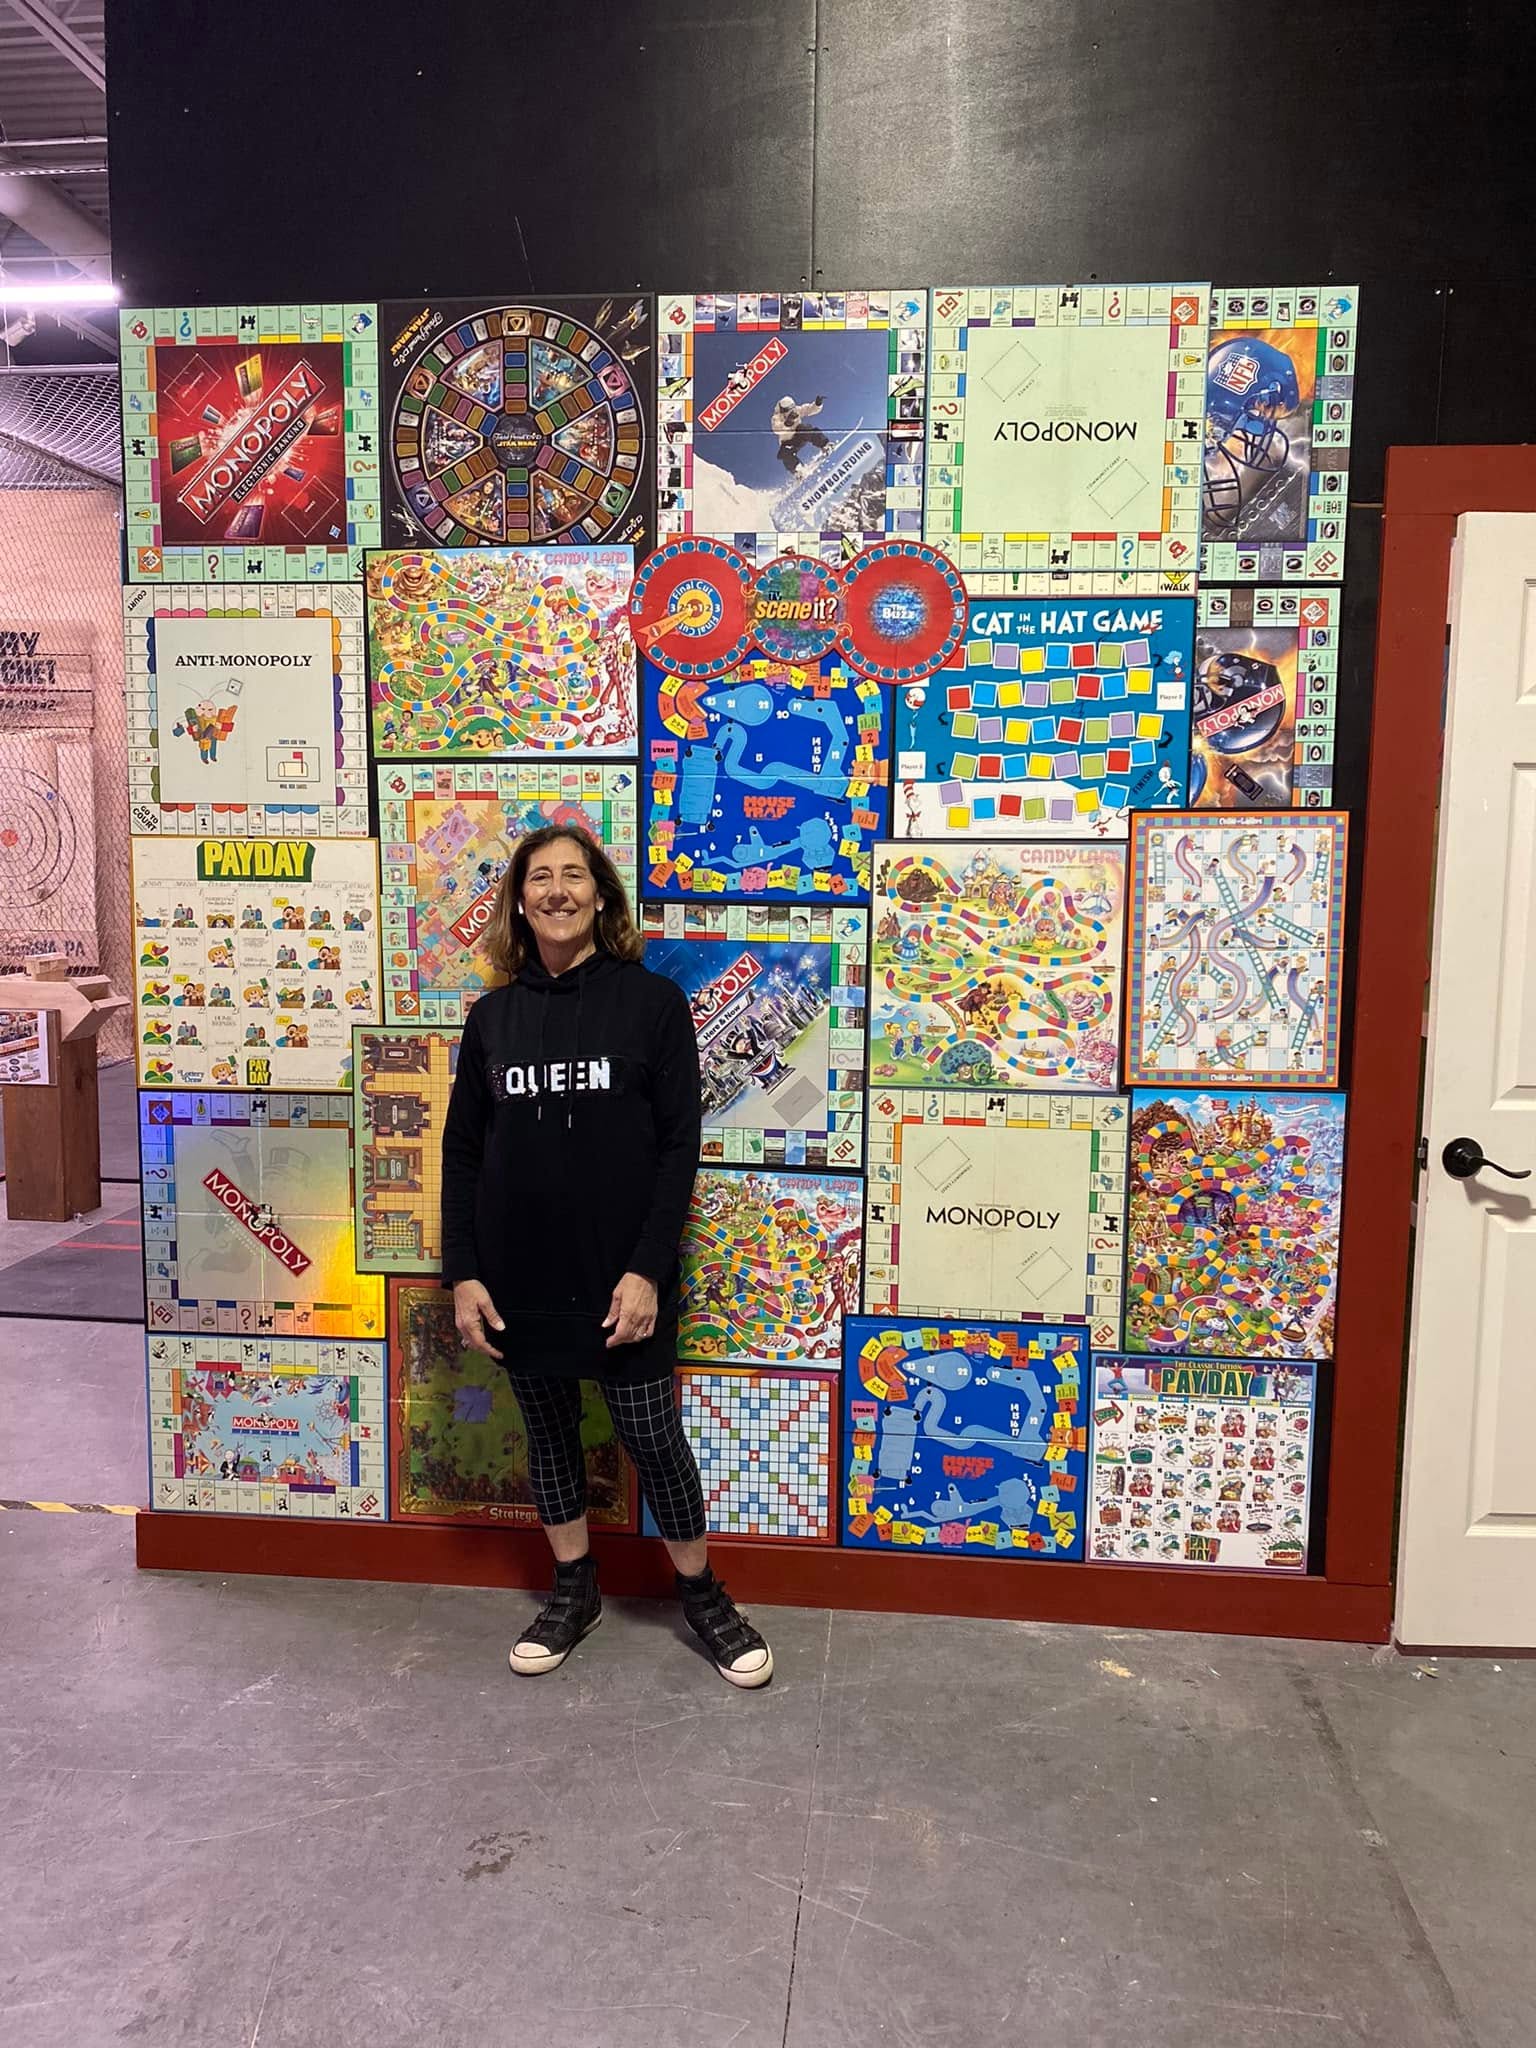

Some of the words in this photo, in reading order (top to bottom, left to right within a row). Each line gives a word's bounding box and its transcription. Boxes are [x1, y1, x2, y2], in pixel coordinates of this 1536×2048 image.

[937, 296, 959, 318] GO
[703, 341, 783, 427] MONOPOLY
[1228, 358, 1257, 392] NFL
[994, 422, 1138, 441] MONOPOLY
[191, 371, 313, 514] MONOPOLY
[233, 453, 274, 501] ELECTRONIC
[273, 420, 306, 454] BANKING
[801, 441, 873, 511] SNOWBOARDING
[544, 552, 589, 565] CANDY
[593, 551, 628, 565] LAND
[1314, 550, 1337, 572] GO
[672, 579, 695, 600] Final
[696, 581, 714, 595] Cut
[1164, 584, 1190, 592] WALK
[127, 590, 147, 612] COURT
[754, 600, 813, 620] scene
[813, 598, 838, 620] it?
[882, 608, 916, 619] Buzz
[1019, 613, 1031, 623] IN
[1041, 611, 1088, 634] HAT
[1093, 609, 1163, 633] GAME
[972, 612, 1014, 635] CAT
[1016, 625, 1036, 635] THE
[175, 654, 312, 668] ANTI-MONOPOLY
[709, 713, 721, 722] 24
[776, 711, 790, 719] 20
[1200, 686, 1285, 735] MONOPOLY
[1133, 770, 1154, 796] FINISH
[715, 794, 721, 803] 9
[743, 796, 796, 809] MOUSE
[132, 808, 157, 832] COURT
[140, 805, 153, 817] GO
[150, 815, 159, 824] TO
[712, 809, 723, 817] 10
[745, 807, 788, 819] TRAP
[710, 842, 716, 850] 6
[736, 835, 742, 843] 7
[203, 840, 310, 878] PAYDAY
[1020, 849, 1077, 864] CANDY
[1079, 849, 1121, 864] LAND
[702, 1022, 721, 1041] Here
[725, 1004, 741, 1020] Now
[181, 1070, 204, 1079] Lottery
[249, 1059, 267, 1072] PAY
[249, 1072, 269, 1084] DAY
[504, 1058, 611, 1096] QUEEN
[835, 1139, 855, 1159] GO
[205, 1172, 309, 1271] MONOPOLY
[926, 1206, 1061, 1230] MONOPOLY
[154, 1306, 173, 1324] GO
[1094, 1324, 1115, 1343] GO
[909, 1378, 920, 1386] 24
[1162, 1368, 1252, 1397] PAYDAY
[232, 1416, 298, 1429] MONOPOLY
[914, 1452, 920, 1460] 9
[911, 1466, 922, 1474] 10
[360, 1494, 378, 1512] GO
[909, 1497, 915, 1505] 6
[935, 1491, 941, 1499] 7
[489, 1507, 538, 1524] Stratego
[1190, 1536, 1211, 1548] PAY
[1190, 1549, 1211, 1562] DAY
